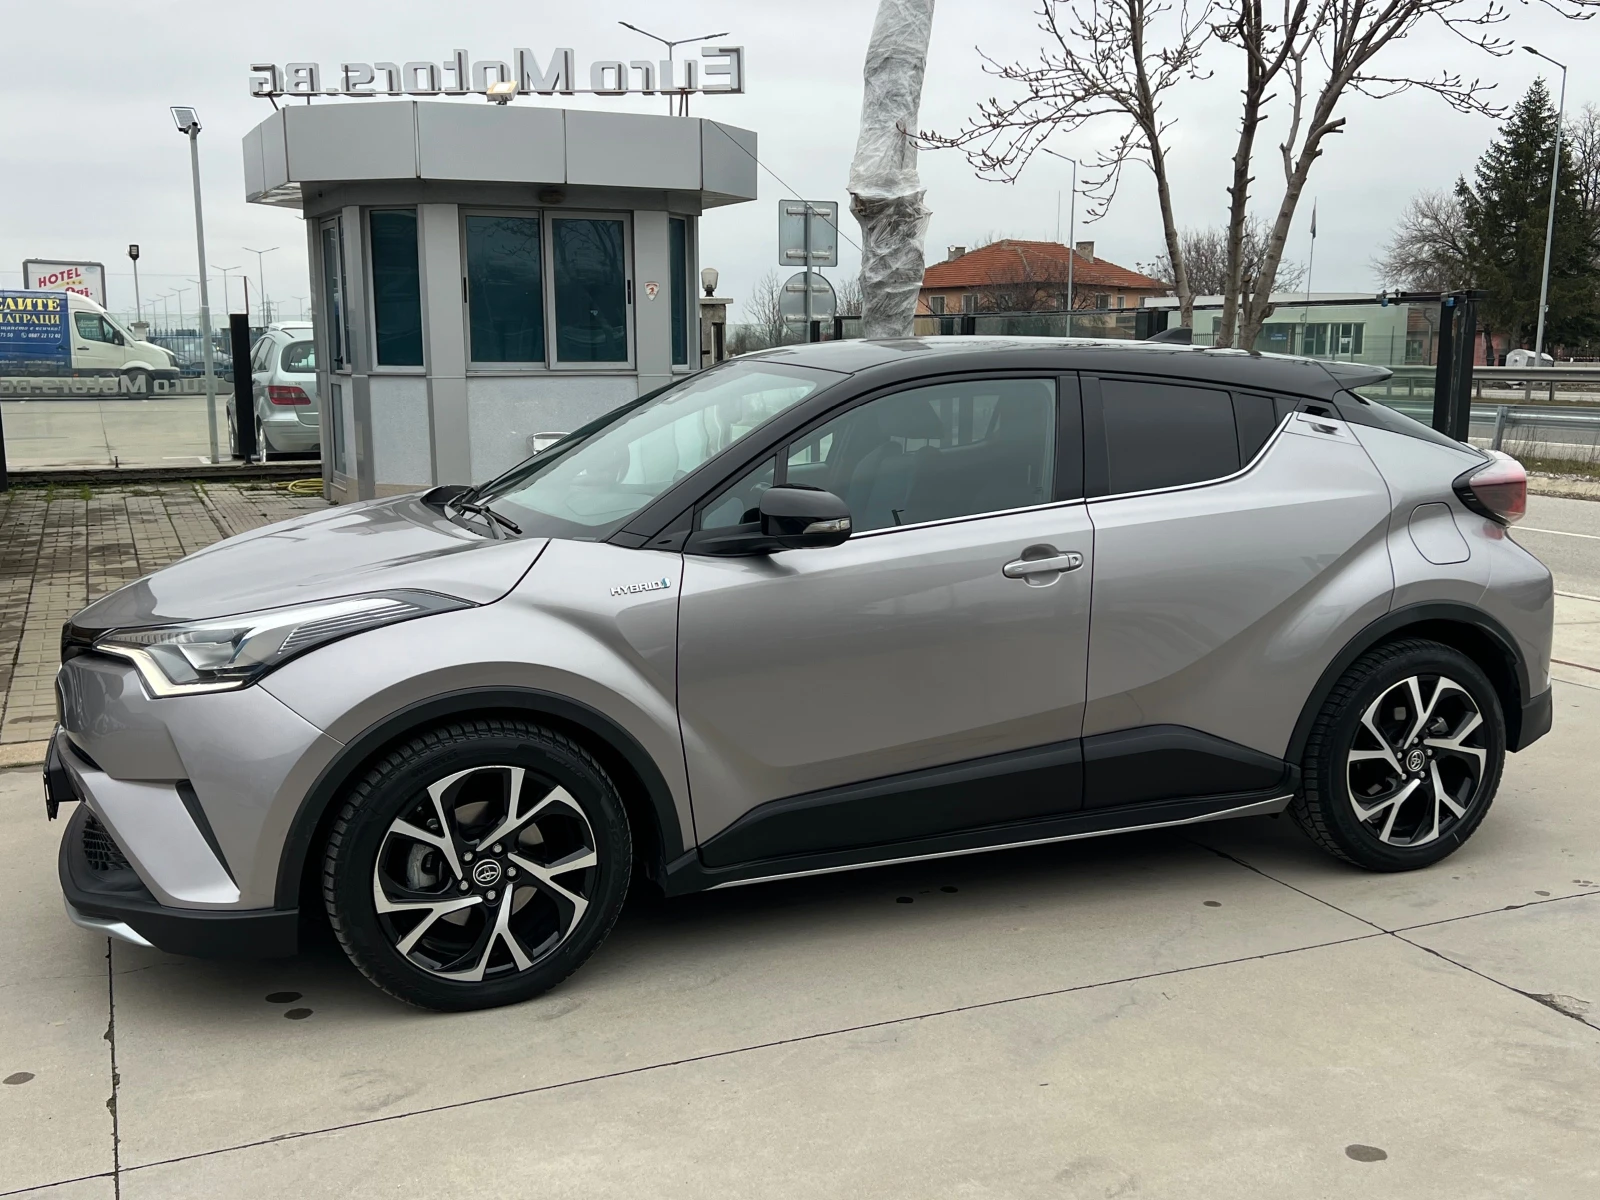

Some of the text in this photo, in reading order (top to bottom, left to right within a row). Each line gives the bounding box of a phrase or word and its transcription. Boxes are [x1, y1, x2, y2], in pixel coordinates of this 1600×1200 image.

[38, 267, 81, 288] HOTEL
[0, 297, 60, 311] ЛИТЕ
[0, 313, 60, 325] АТРАЦИ
[610, 580, 663, 596] HYBRID
